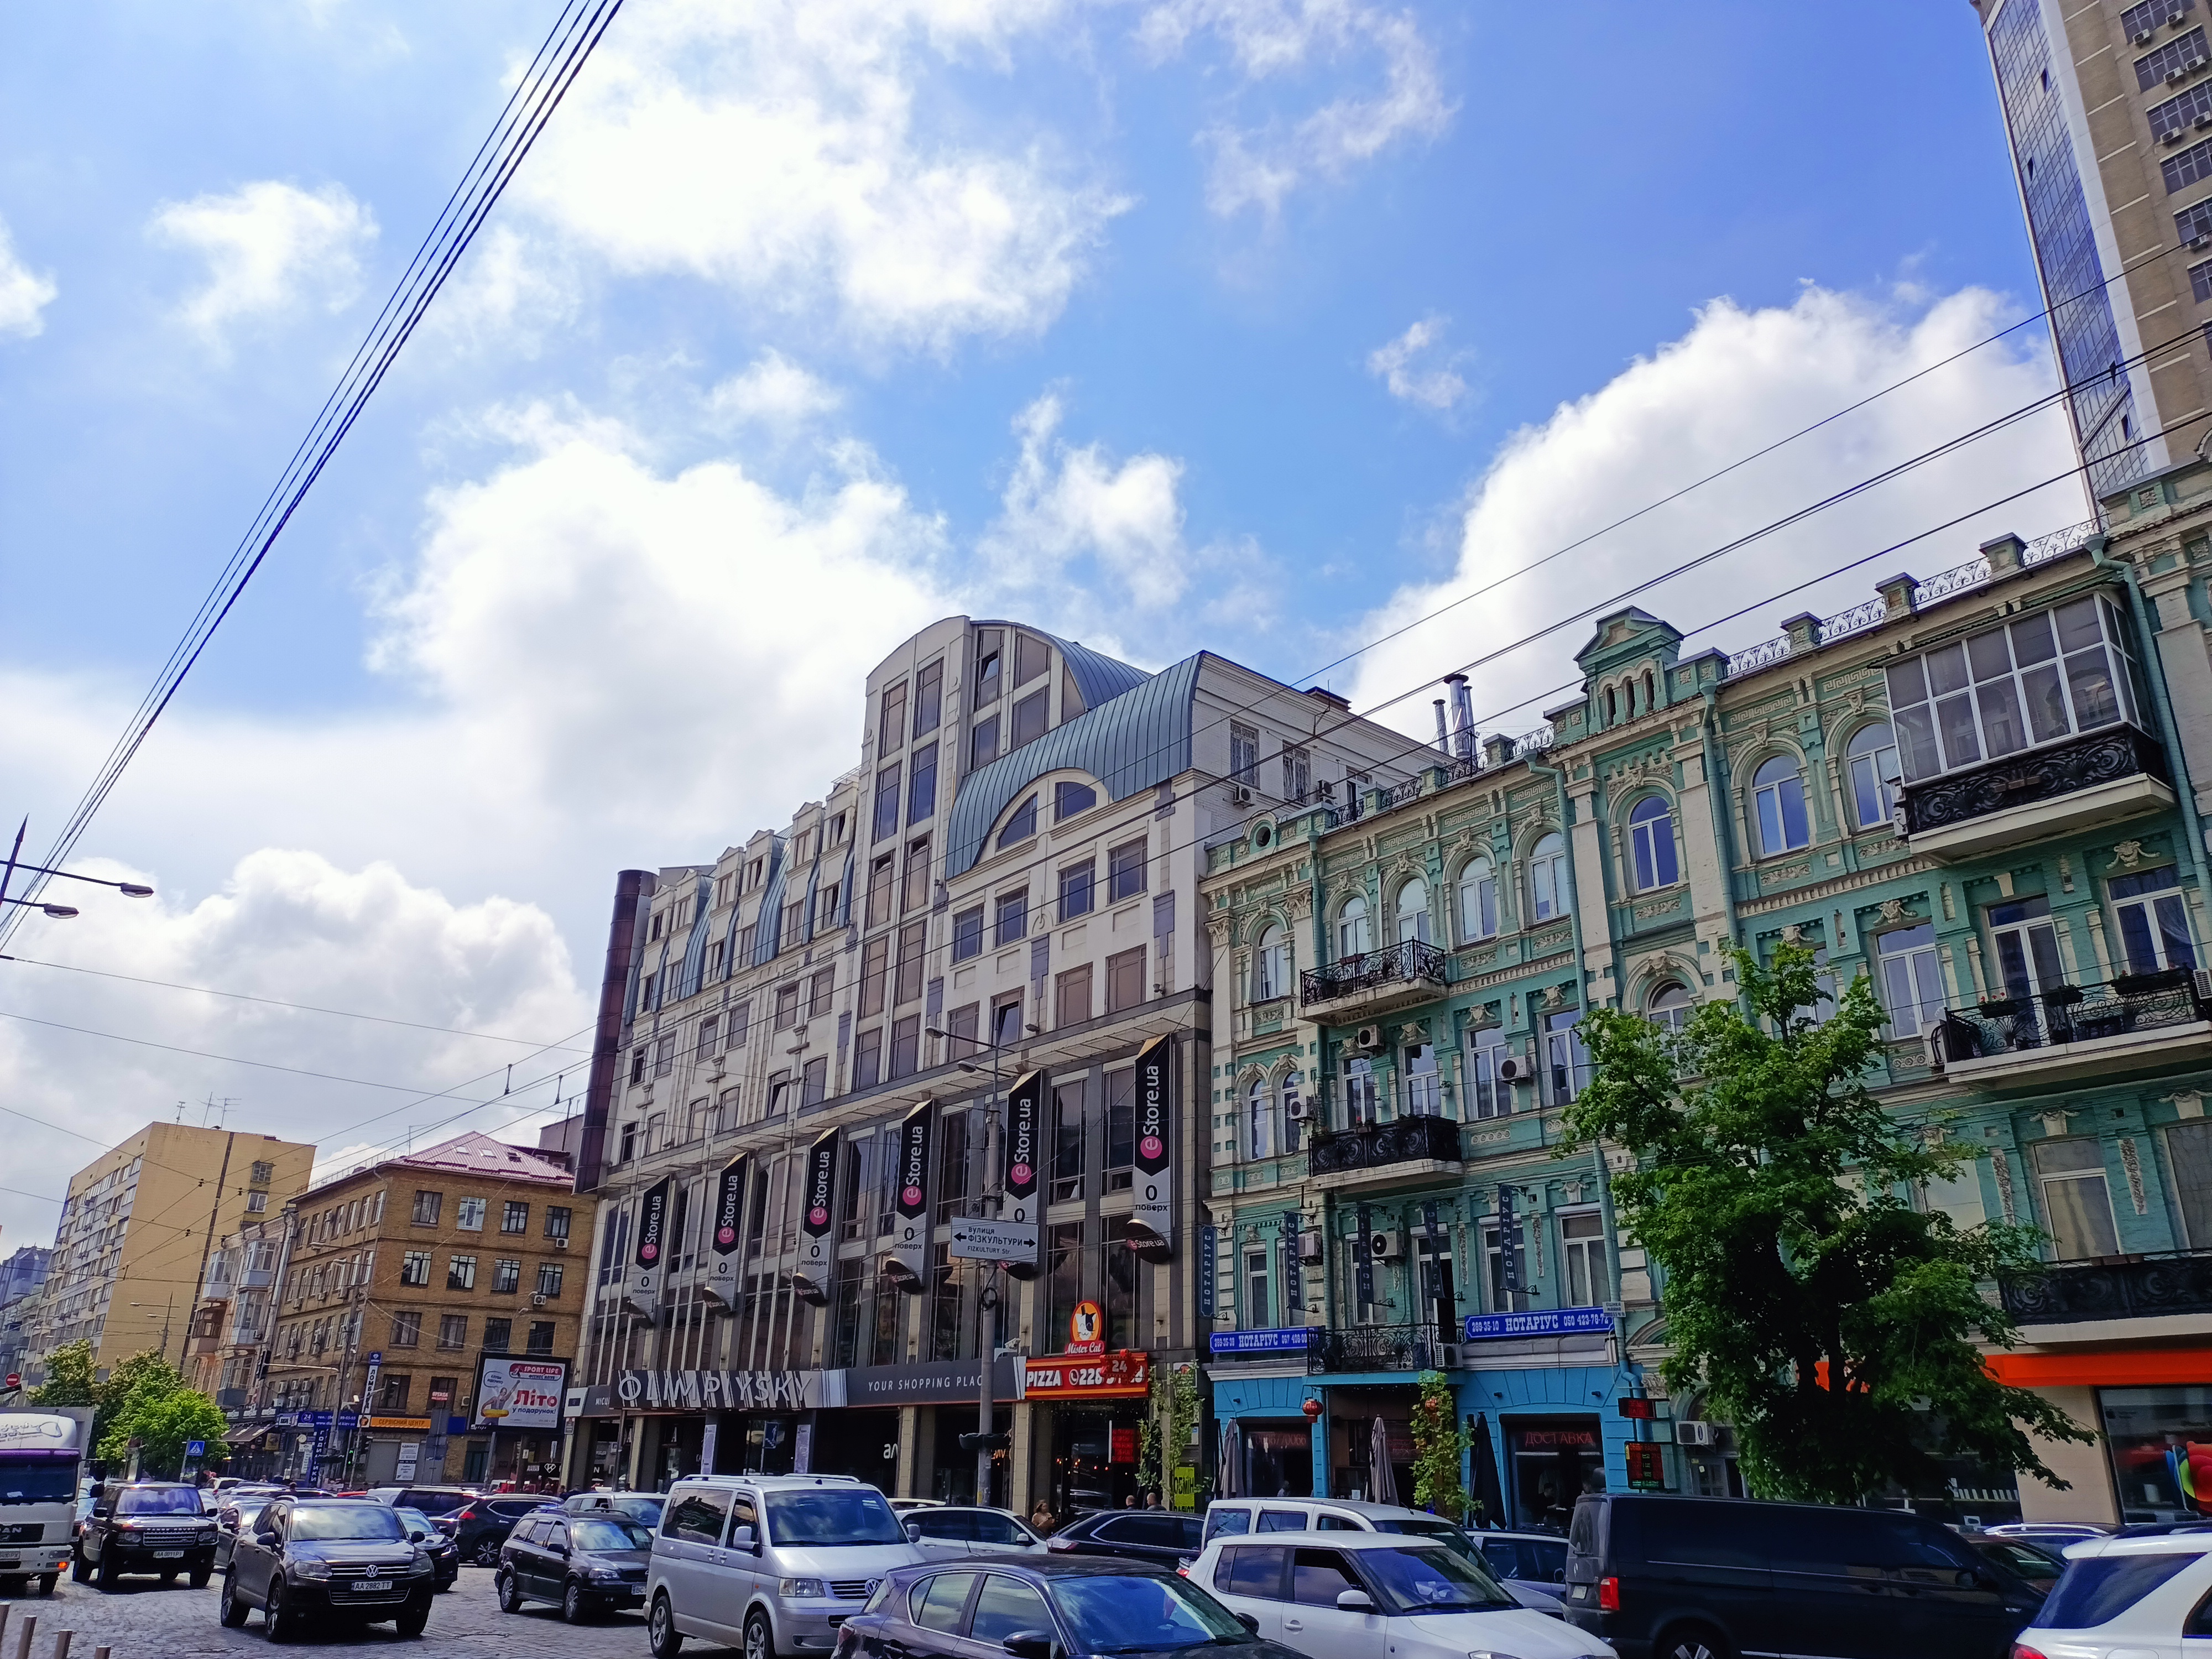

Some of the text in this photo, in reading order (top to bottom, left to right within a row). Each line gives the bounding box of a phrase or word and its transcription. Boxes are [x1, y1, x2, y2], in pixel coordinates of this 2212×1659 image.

[1143, 1065, 1159, 1150] eStore.ua
[1014, 1098, 1031, 1176] eStore.ua
[906, 1126, 923, 1198] eStore.ua
[813, 1151, 830, 1218] eStore.ua
[721, 1175, 738, 1238] eStore.ua
[645, 1196, 661, 1253] eStore.ua
[968, 1234, 1022, 1246] ФІЗКУЛЬТУРИ
[1502, 1196, 1515, 1280] НОТАРІУС
[1288, 1223, 1297, 1296] НОТАРІУС
[1505, 1314, 1559, 1332] НОТАРІУС
[1563, 1315, 1575, 1327] 050
[1065, 1342, 1102, 1354] Mister Cat
[1239, 1333, 1278, 1348] НОТАРІУС
[1112, 1360, 1128, 1373] 24
[868, 1375, 982, 1391] YOUR SHOPPING PLAC
[1026, 1370, 1062, 1387] PIZZA
[513, 1389, 557, 1407] Літо
[1525, 1432, 1593, 1447] ДОСТАВКА
[0, 1526, 22, 1534] AN
